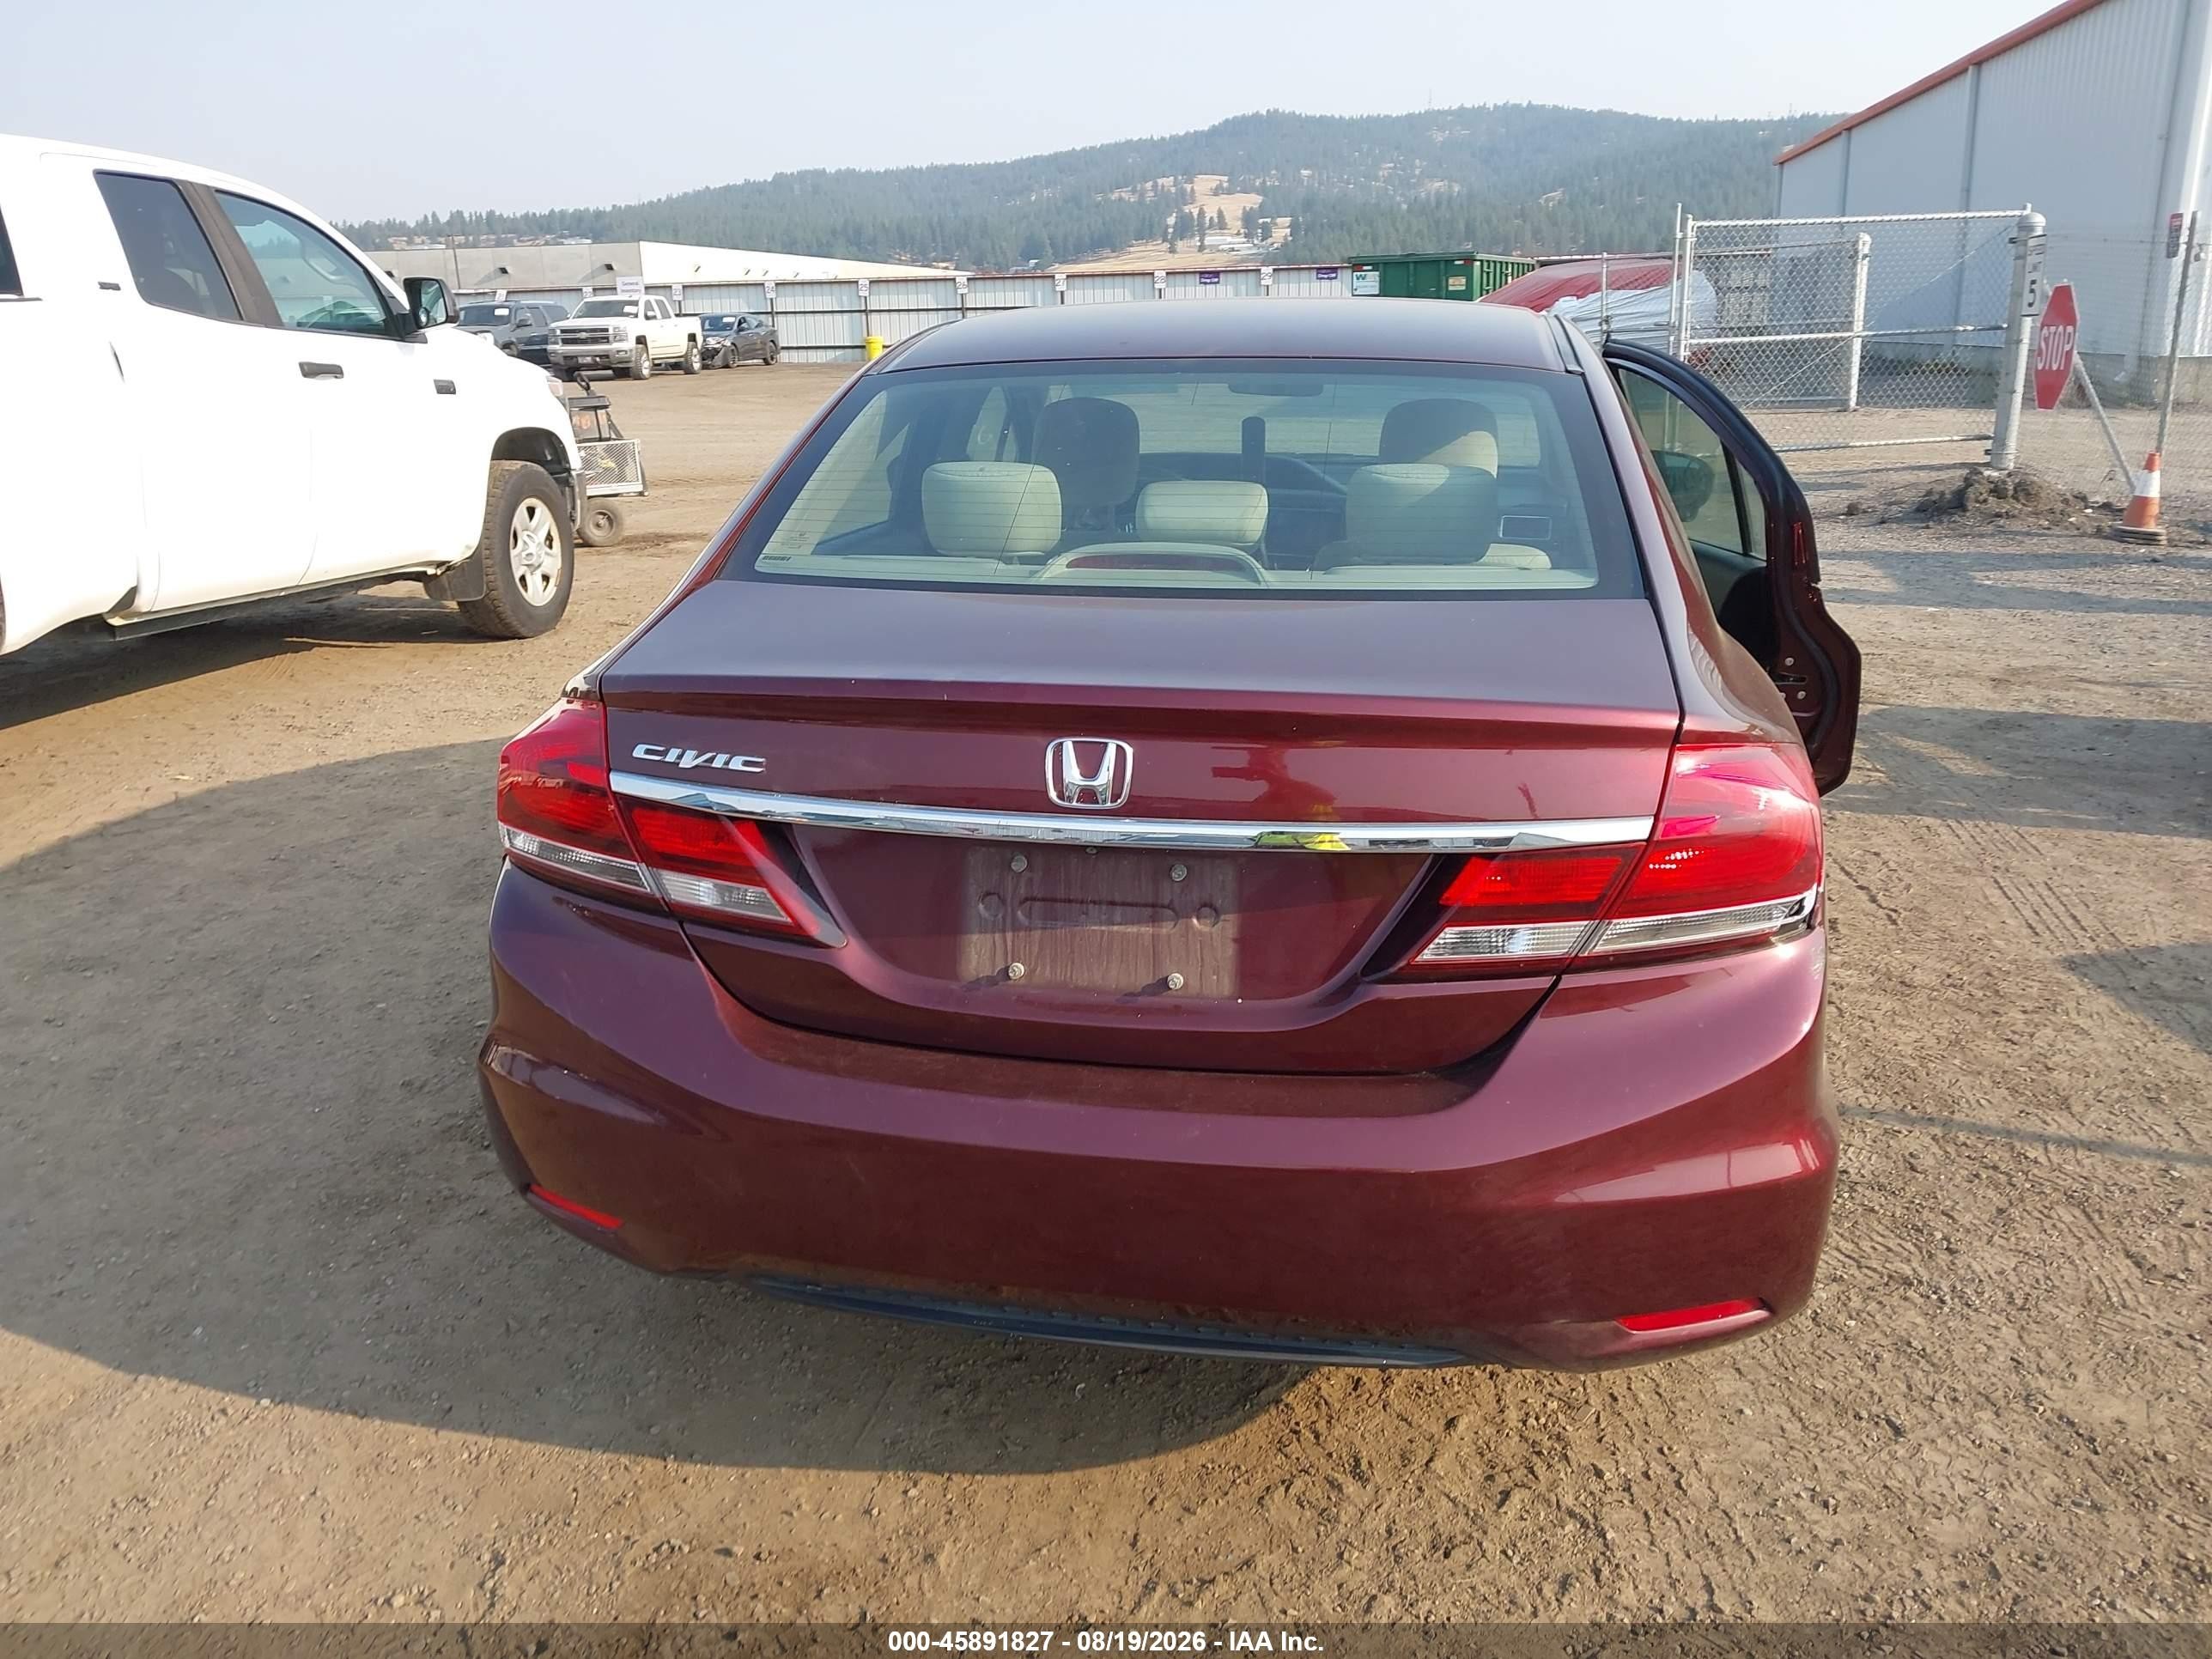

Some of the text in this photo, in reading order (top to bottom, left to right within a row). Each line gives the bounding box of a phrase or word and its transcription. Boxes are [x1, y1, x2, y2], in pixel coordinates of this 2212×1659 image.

[1154, 276, 1166, 284] 28
[1260, 271, 1272, 281] 29
[956, 281, 968, 289] 26
[1055, 278, 1066, 287] 27
[672, 288, 682, 296] 23
[765, 285, 775, 294] 24
[859, 283, 869, 292] 25
[2027, 279, 2038, 308] 5
[2037, 325, 2075, 371] STOP
[632, 744, 767, 773] CIVIC
